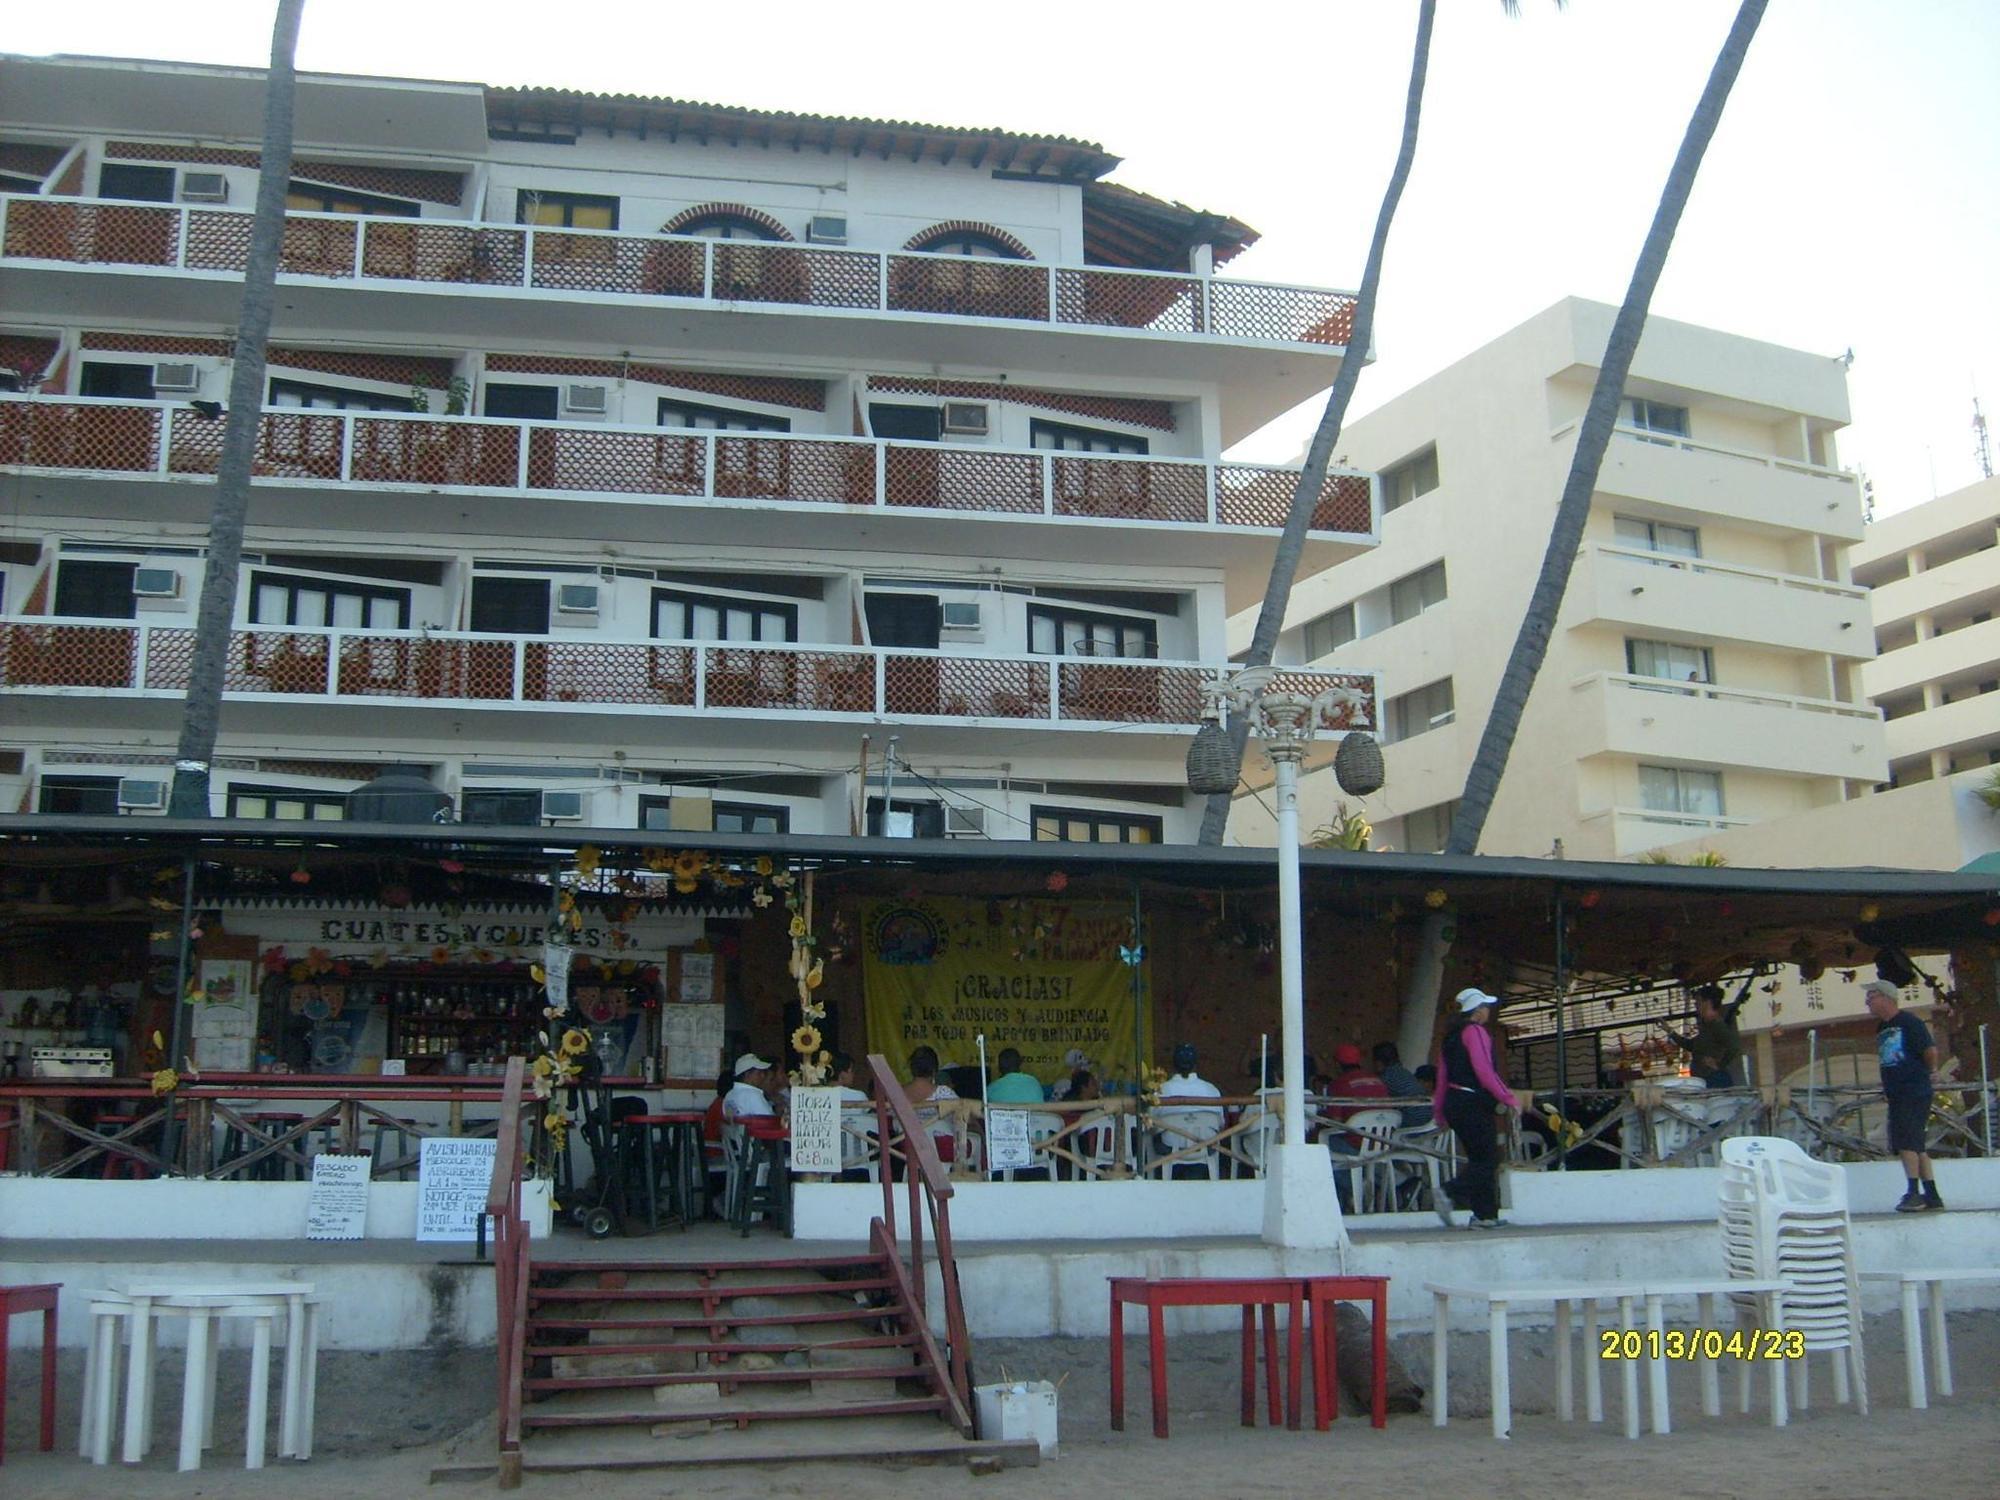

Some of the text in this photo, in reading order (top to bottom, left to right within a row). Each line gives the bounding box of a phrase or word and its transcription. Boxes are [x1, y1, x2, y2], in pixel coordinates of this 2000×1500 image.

[322, 920, 601, 947] CUATES Y CUEES
[922, 1006, 944, 1021] LOS
[952, 1007, 1009, 1022] MUSICOS
[1016, 1008, 1026, 1023] Y
[904, 1025, 928, 1040] POR
[933, 1025, 966, 1040] TODO
[992, 1027, 1036, 1042] APOYO
[1041, 1026, 1110, 1042] BRINDADO
[797, 1092, 832, 1109] HORA
[796, 1110, 832, 1123] FELIZ
[796, 1124, 832, 1137] HAPPY
[796, 1138, 832, 1149] HOUR
